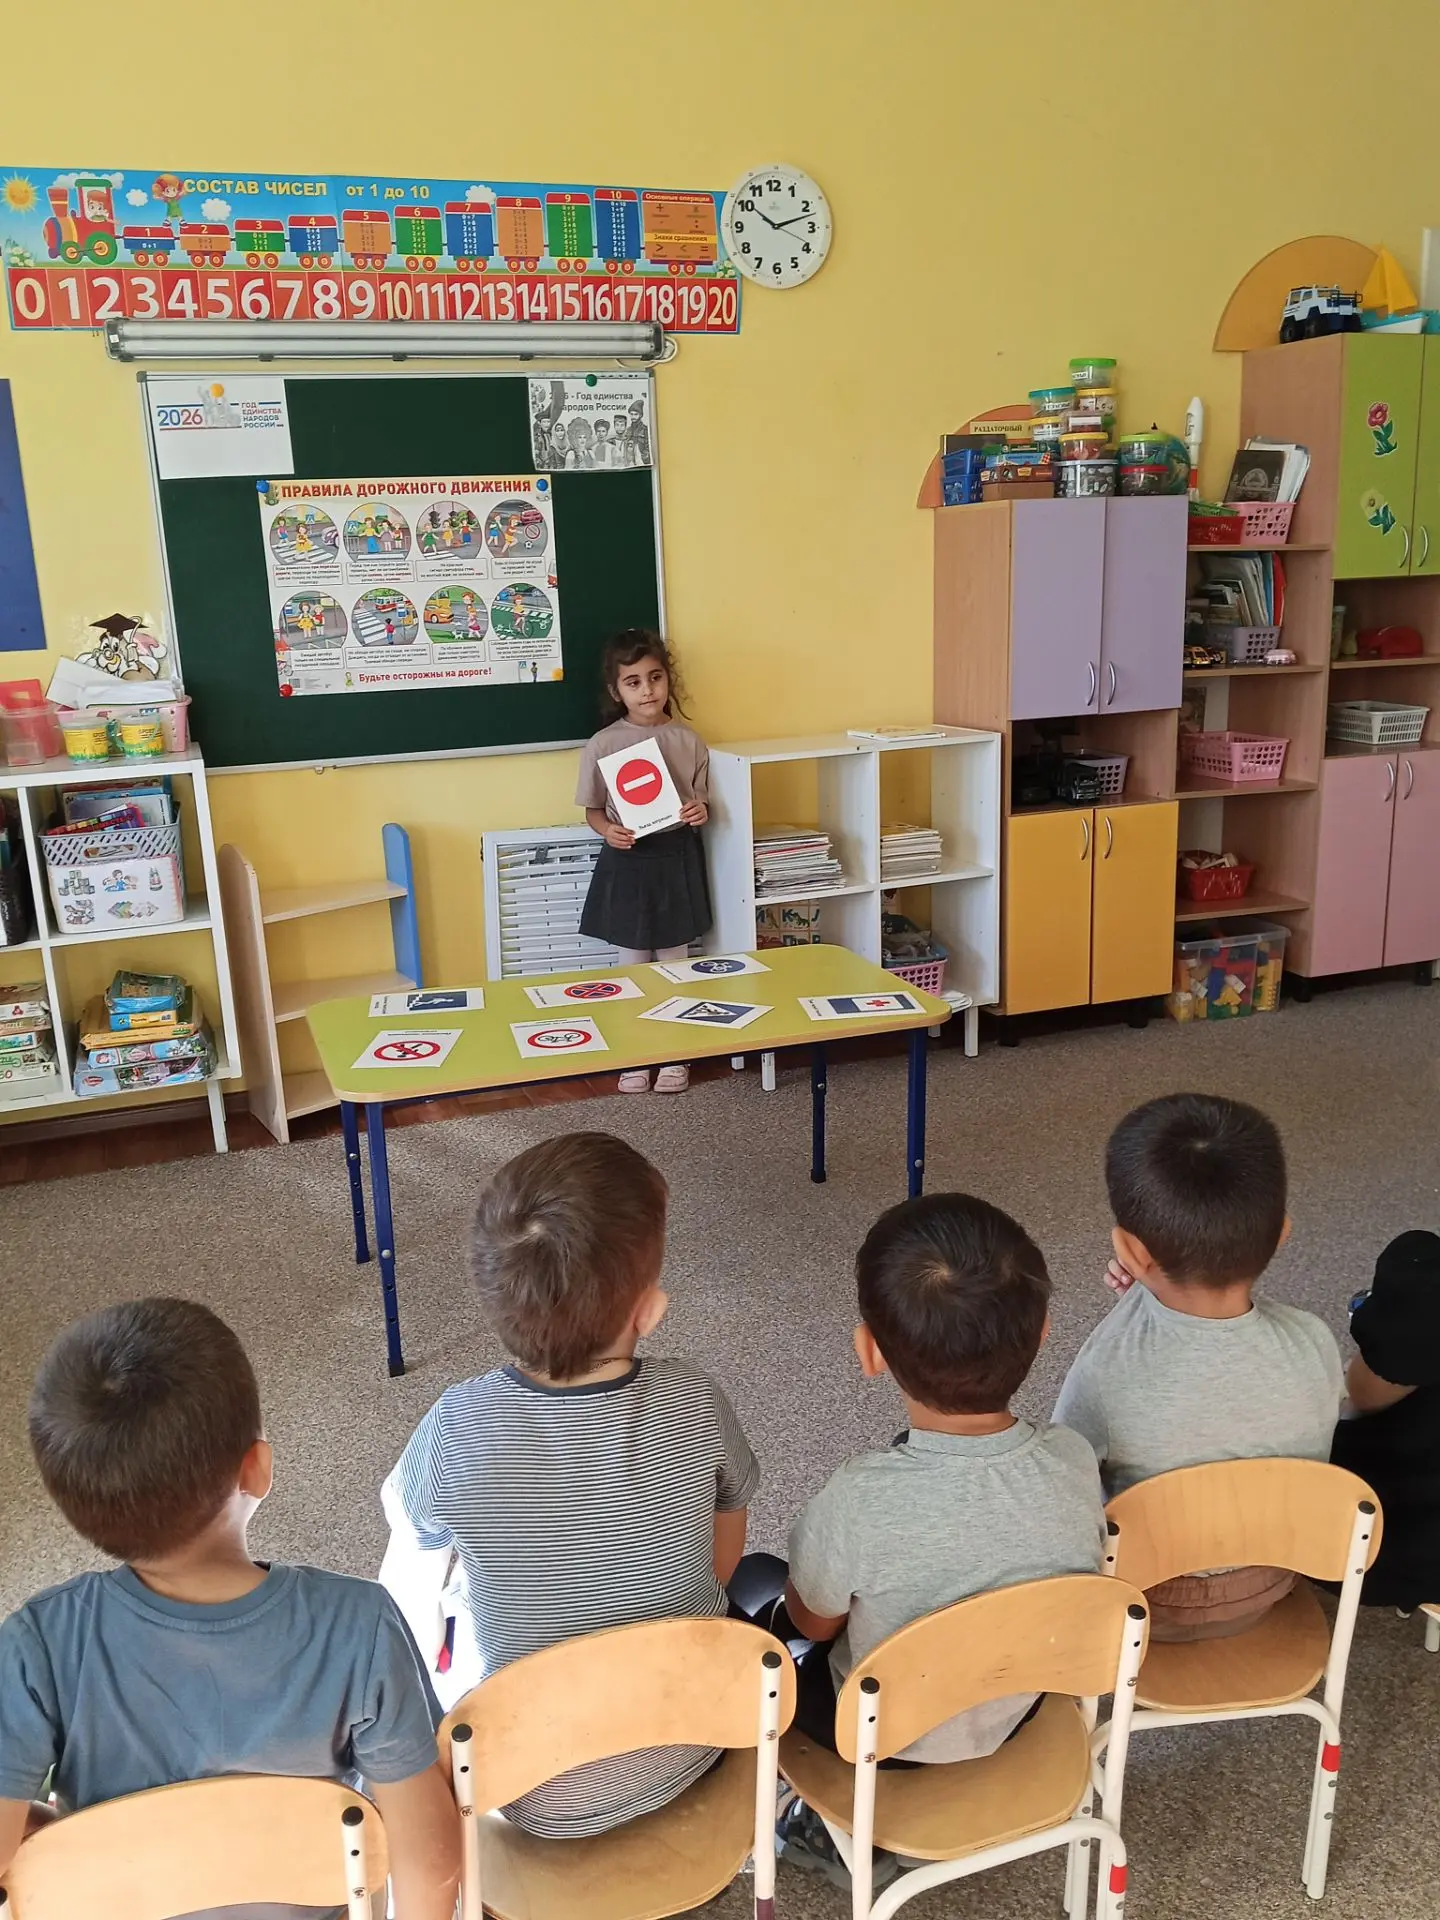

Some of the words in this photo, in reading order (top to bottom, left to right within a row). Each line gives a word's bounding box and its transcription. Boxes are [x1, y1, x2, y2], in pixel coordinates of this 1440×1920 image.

[184, 179, 259, 194] СОСТАВ
[265, 182, 327, 196] ЧИСЕЛ
[346, 186, 364, 196] от
[370, 184, 377, 196] 1
[384, 187, 404, 199] до
[410, 185, 430, 198] 10
[749, 185, 762, 197] 11
[766, 180, 781, 191] 12
[610, 191, 622, 199] 10
[788, 186, 795, 197] 1
[515, 199, 522, 207] 8
[565, 194, 571, 202] 9
[464, 204, 471, 212] 7
[738, 200, 755, 212] 10
[802, 201, 810, 212] 2
[363, 212, 369, 220] 5
[414, 208, 421, 216] 6
[256, 221, 262, 230] 3
[309, 217, 316, 226] 4
[735, 221, 744, 233] 9
[145, 228, 150, 236] 1
[201, 225, 208, 234] 2
[808, 222, 816, 233] 3
[742, 242, 751, 254] 8
[802, 242, 811, 254] 4
[754, 257, 763, 269] 7
[791, 257, 799, 268] 5
[773, 263, 782, 274] 6
[16, 278, 45, 319] 0
[59, 278, 80, 319] 1
[93, 277, 125, 319] 2
[131, 277, 159, 319] 3
[167, 279, 198, 319] 4
[207, 279, 233, 319] 5
[241, 279, 270, 319] 6
[277, 279, 303, 319] 7
[312, 279, 341, 320] 8
[348, 280, 375, 319] 9
[380, 281, 412, 320] 10
[415, 283, 445, 320] 11
[449, 283, 481, 320] 12
[483, 282, 514, 320] 13
[517, 284, 547, 320] 14
[550, 284, 580, 320] 15
[583, 284, 611, 320] 16
[614, 286, 643, 320] 17
[646, 285, 674, 323] 18
[678, 286, 705, 324] 19
[708, 287, 736, 324] 20
[576, 392, 592, 400] Год
[562, 404, 594, 412] ародов
[157, 409, 203, 426] 2026
[281, 484, 353, 497] ПРАВИЛА
[357, 482, 447, 497] ДОРОЖНОГО
[451, 480, 531, 495] ДВИЖЕНИЯ
[359, 674, 390, 683] Будьте
[393, 671, 443, 680] осторожны
[458, 667, 492, 677] дороге!
